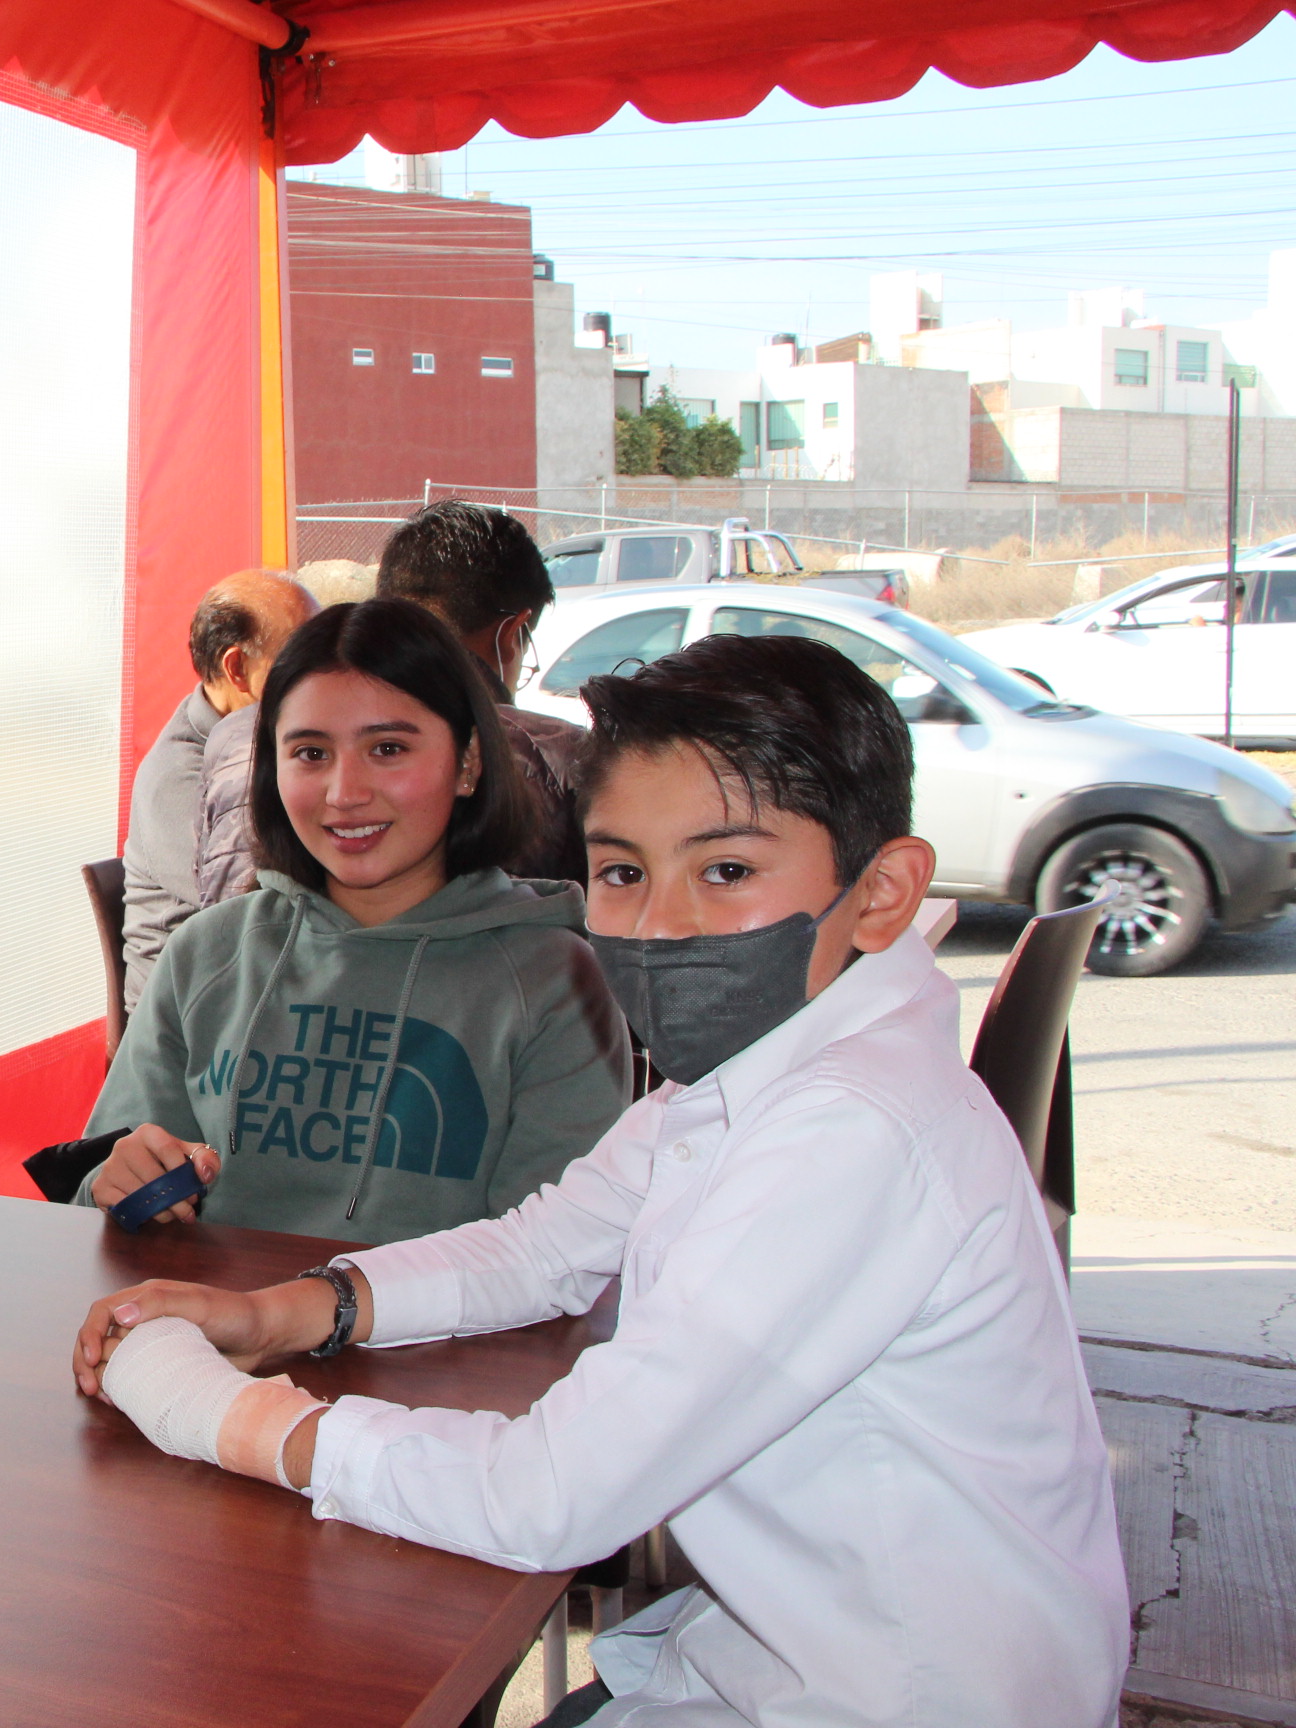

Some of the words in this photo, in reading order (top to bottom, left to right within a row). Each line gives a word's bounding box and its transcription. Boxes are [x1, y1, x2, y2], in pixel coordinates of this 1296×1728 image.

[289, 1004, 399, 1062] THE
[199, 1049, 386, 1112] NORTH
[236, 1102, 373, 1166] FACE
